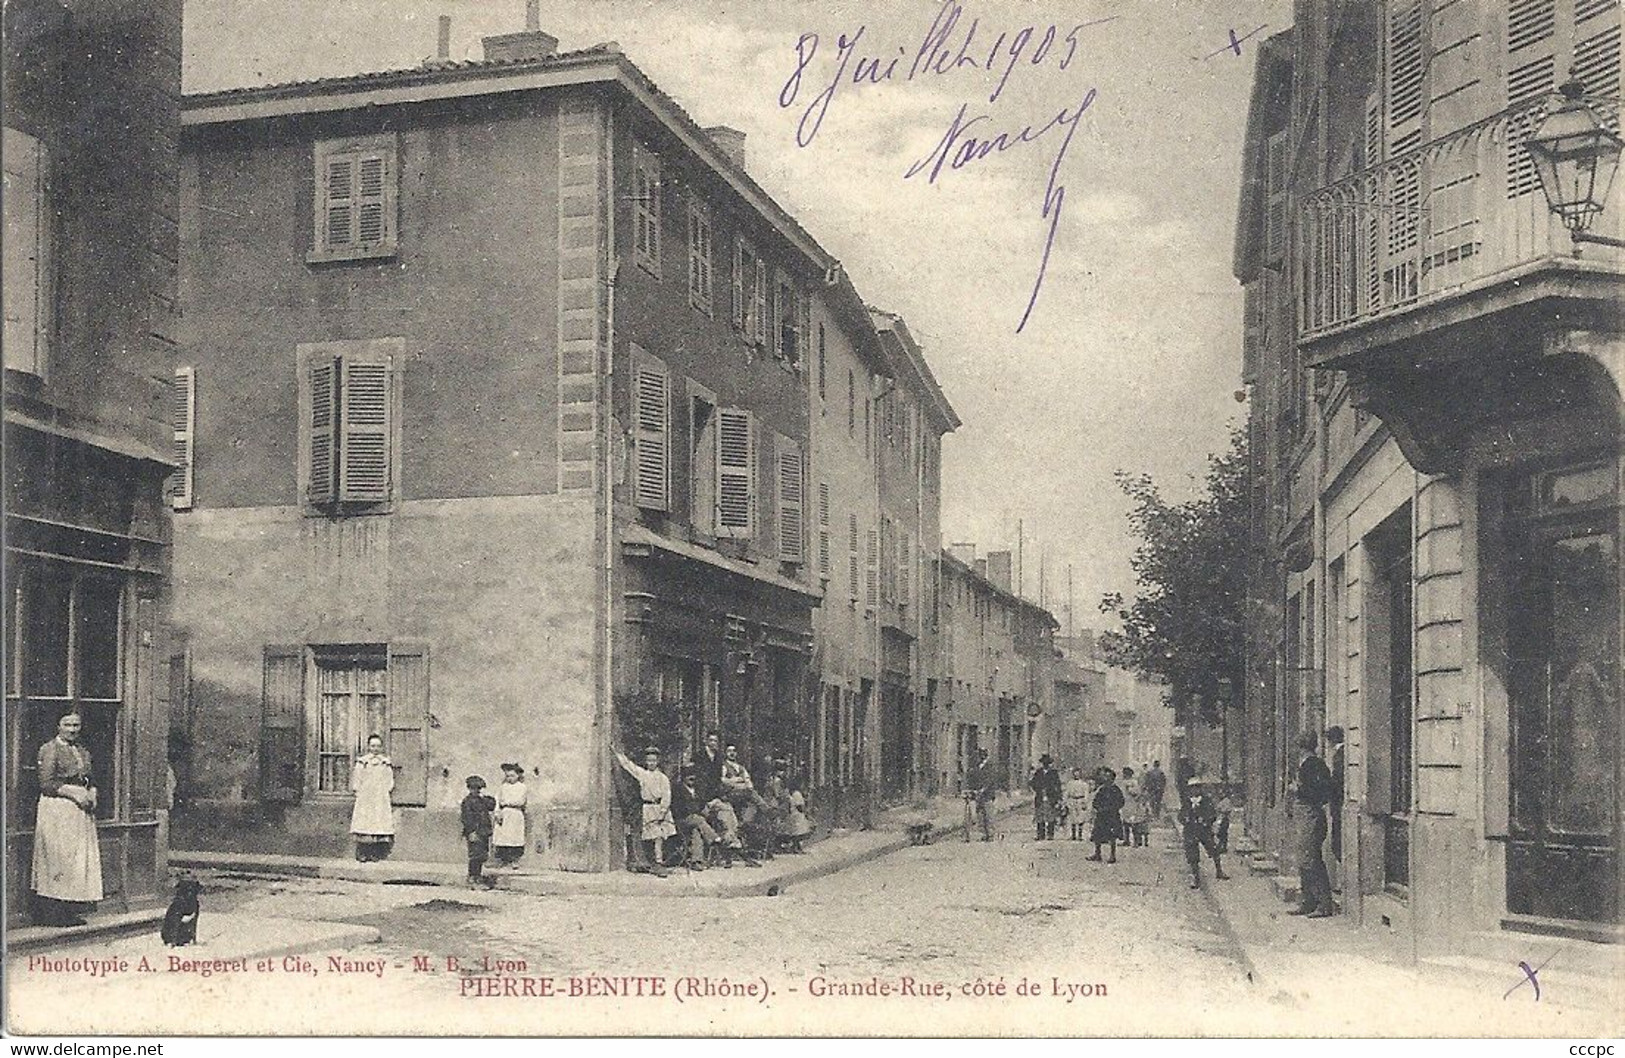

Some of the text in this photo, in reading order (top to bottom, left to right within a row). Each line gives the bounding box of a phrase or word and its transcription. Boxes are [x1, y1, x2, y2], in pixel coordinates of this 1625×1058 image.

[779, 0, 1120, 148] 8 Juillet 1905
[904, 88, 1096, 334] Nancy
